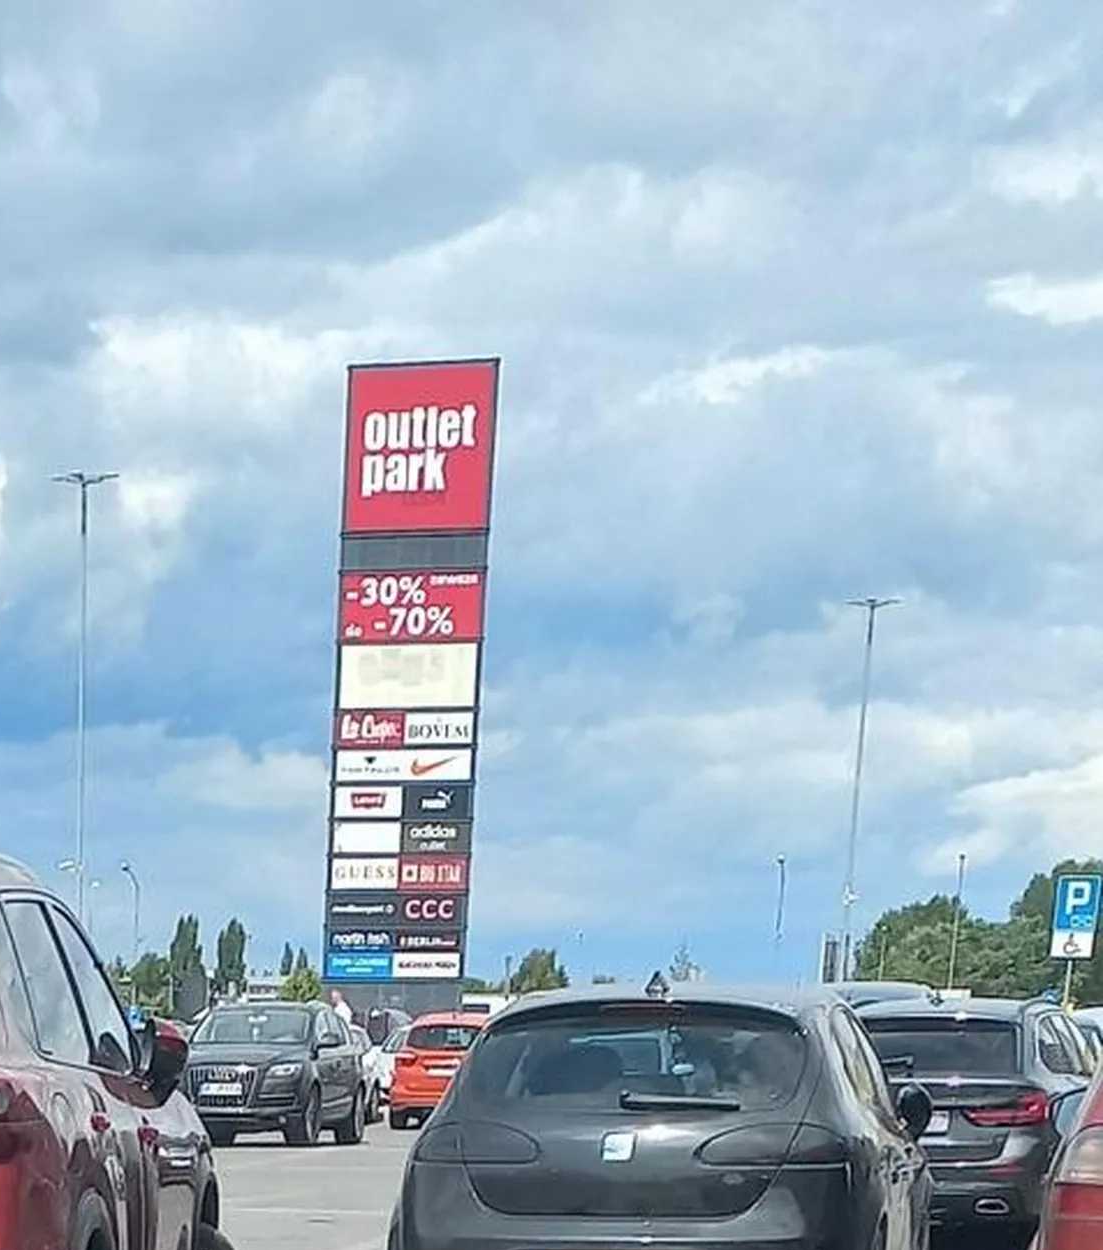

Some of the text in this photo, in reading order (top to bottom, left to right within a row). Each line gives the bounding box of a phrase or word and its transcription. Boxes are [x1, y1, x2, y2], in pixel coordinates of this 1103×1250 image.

[363, 404, 477, 450] outlet
[361, 450, 446, 496] park
[346, 576, 426, 606] -30%
[374, 606, 454, 636] -70%
[410, 823, 457, 838] adidas
[335, 864, 395, 879] GUESS
[405, 900, 454, 919] CCC
[1065, 881, 1092, 915] P
